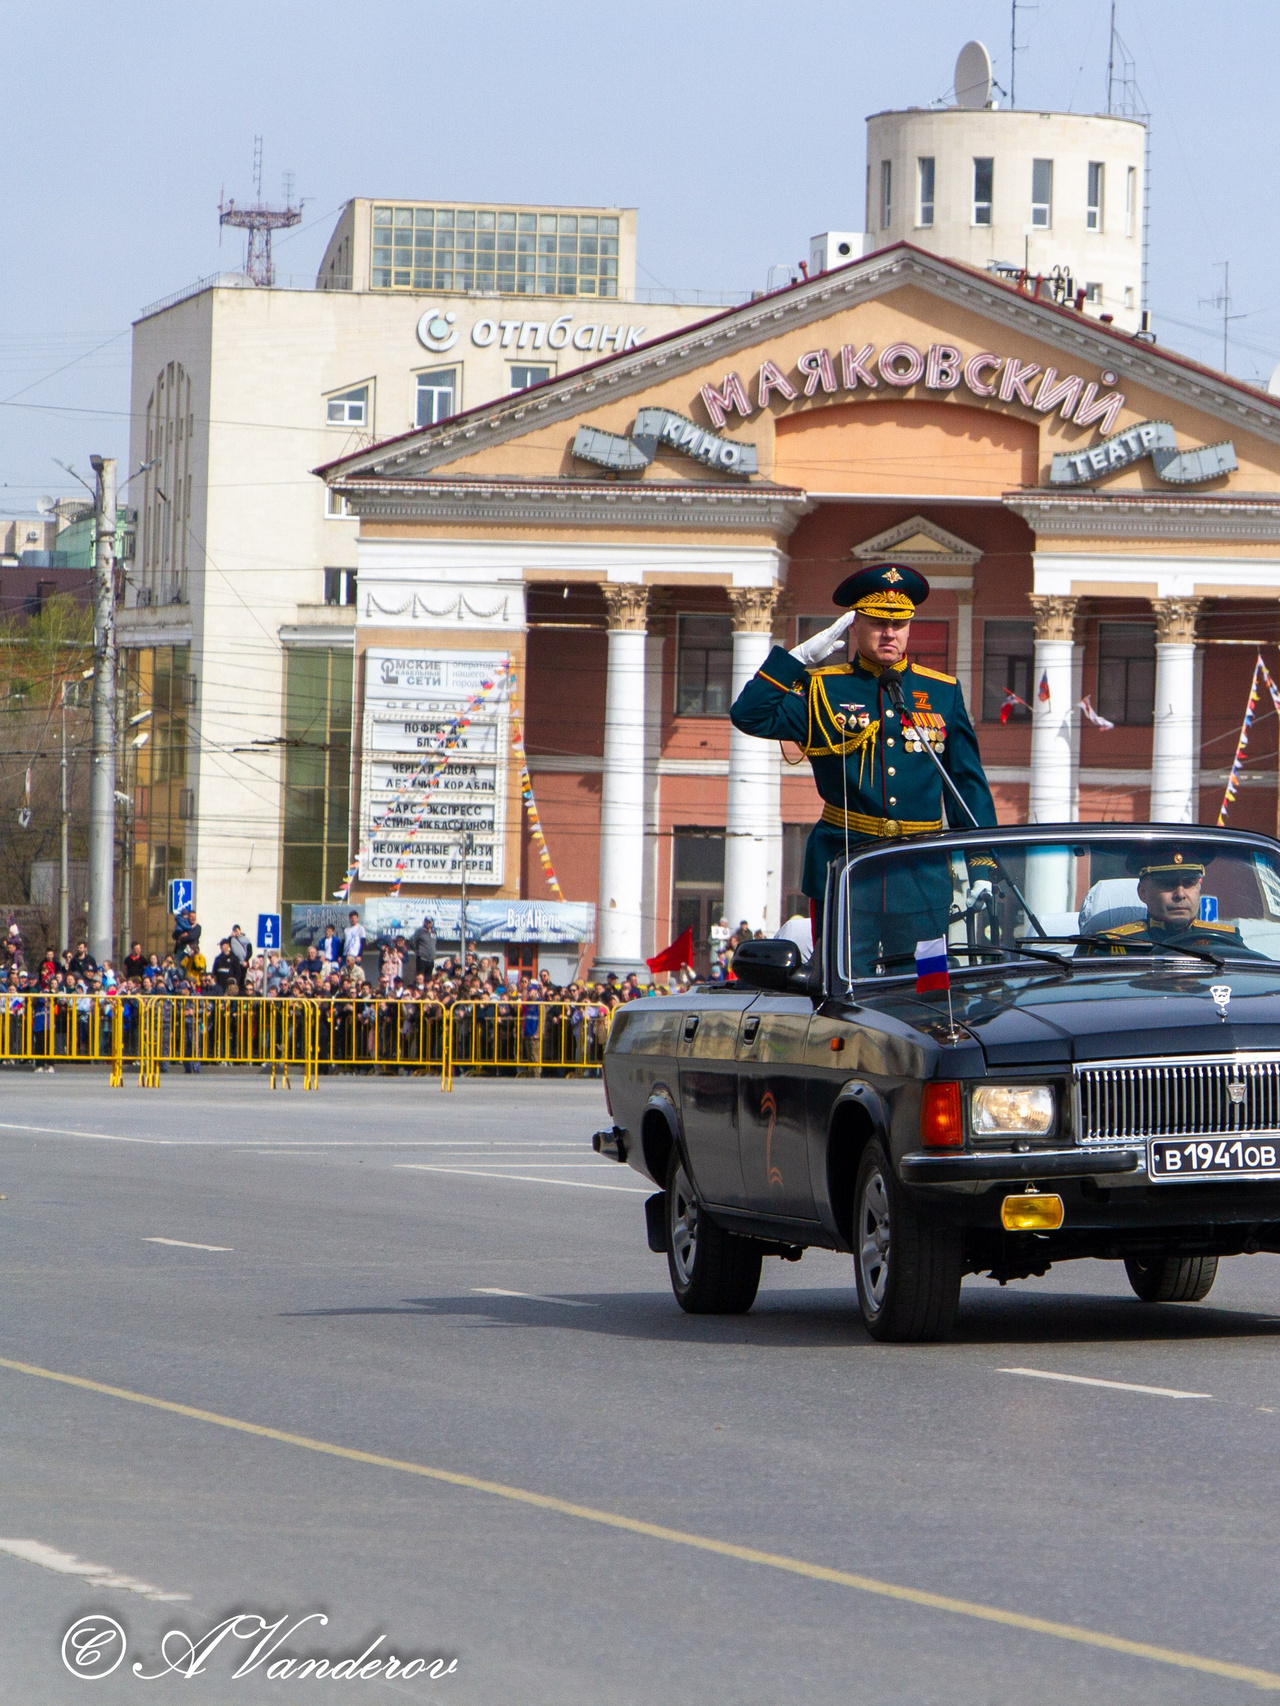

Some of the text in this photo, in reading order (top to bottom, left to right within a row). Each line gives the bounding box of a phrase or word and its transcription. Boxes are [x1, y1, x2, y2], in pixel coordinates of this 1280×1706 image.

[699, 341, 1126, 435] МАЯКОВСКИЙ
[662, 418, 741, 467] КИНО
[1069, 426, 1156, 475] ТЕАТР
[407, 676, 441, 686] СЕТИ
[443, 779, 495, 790] КОРАБЛЬ
[426, 804, 482, 815] ЭКСПРЕСС
[371, 858, 393, 868] СТО
[417, 859, 446, 869] ТОМУ
